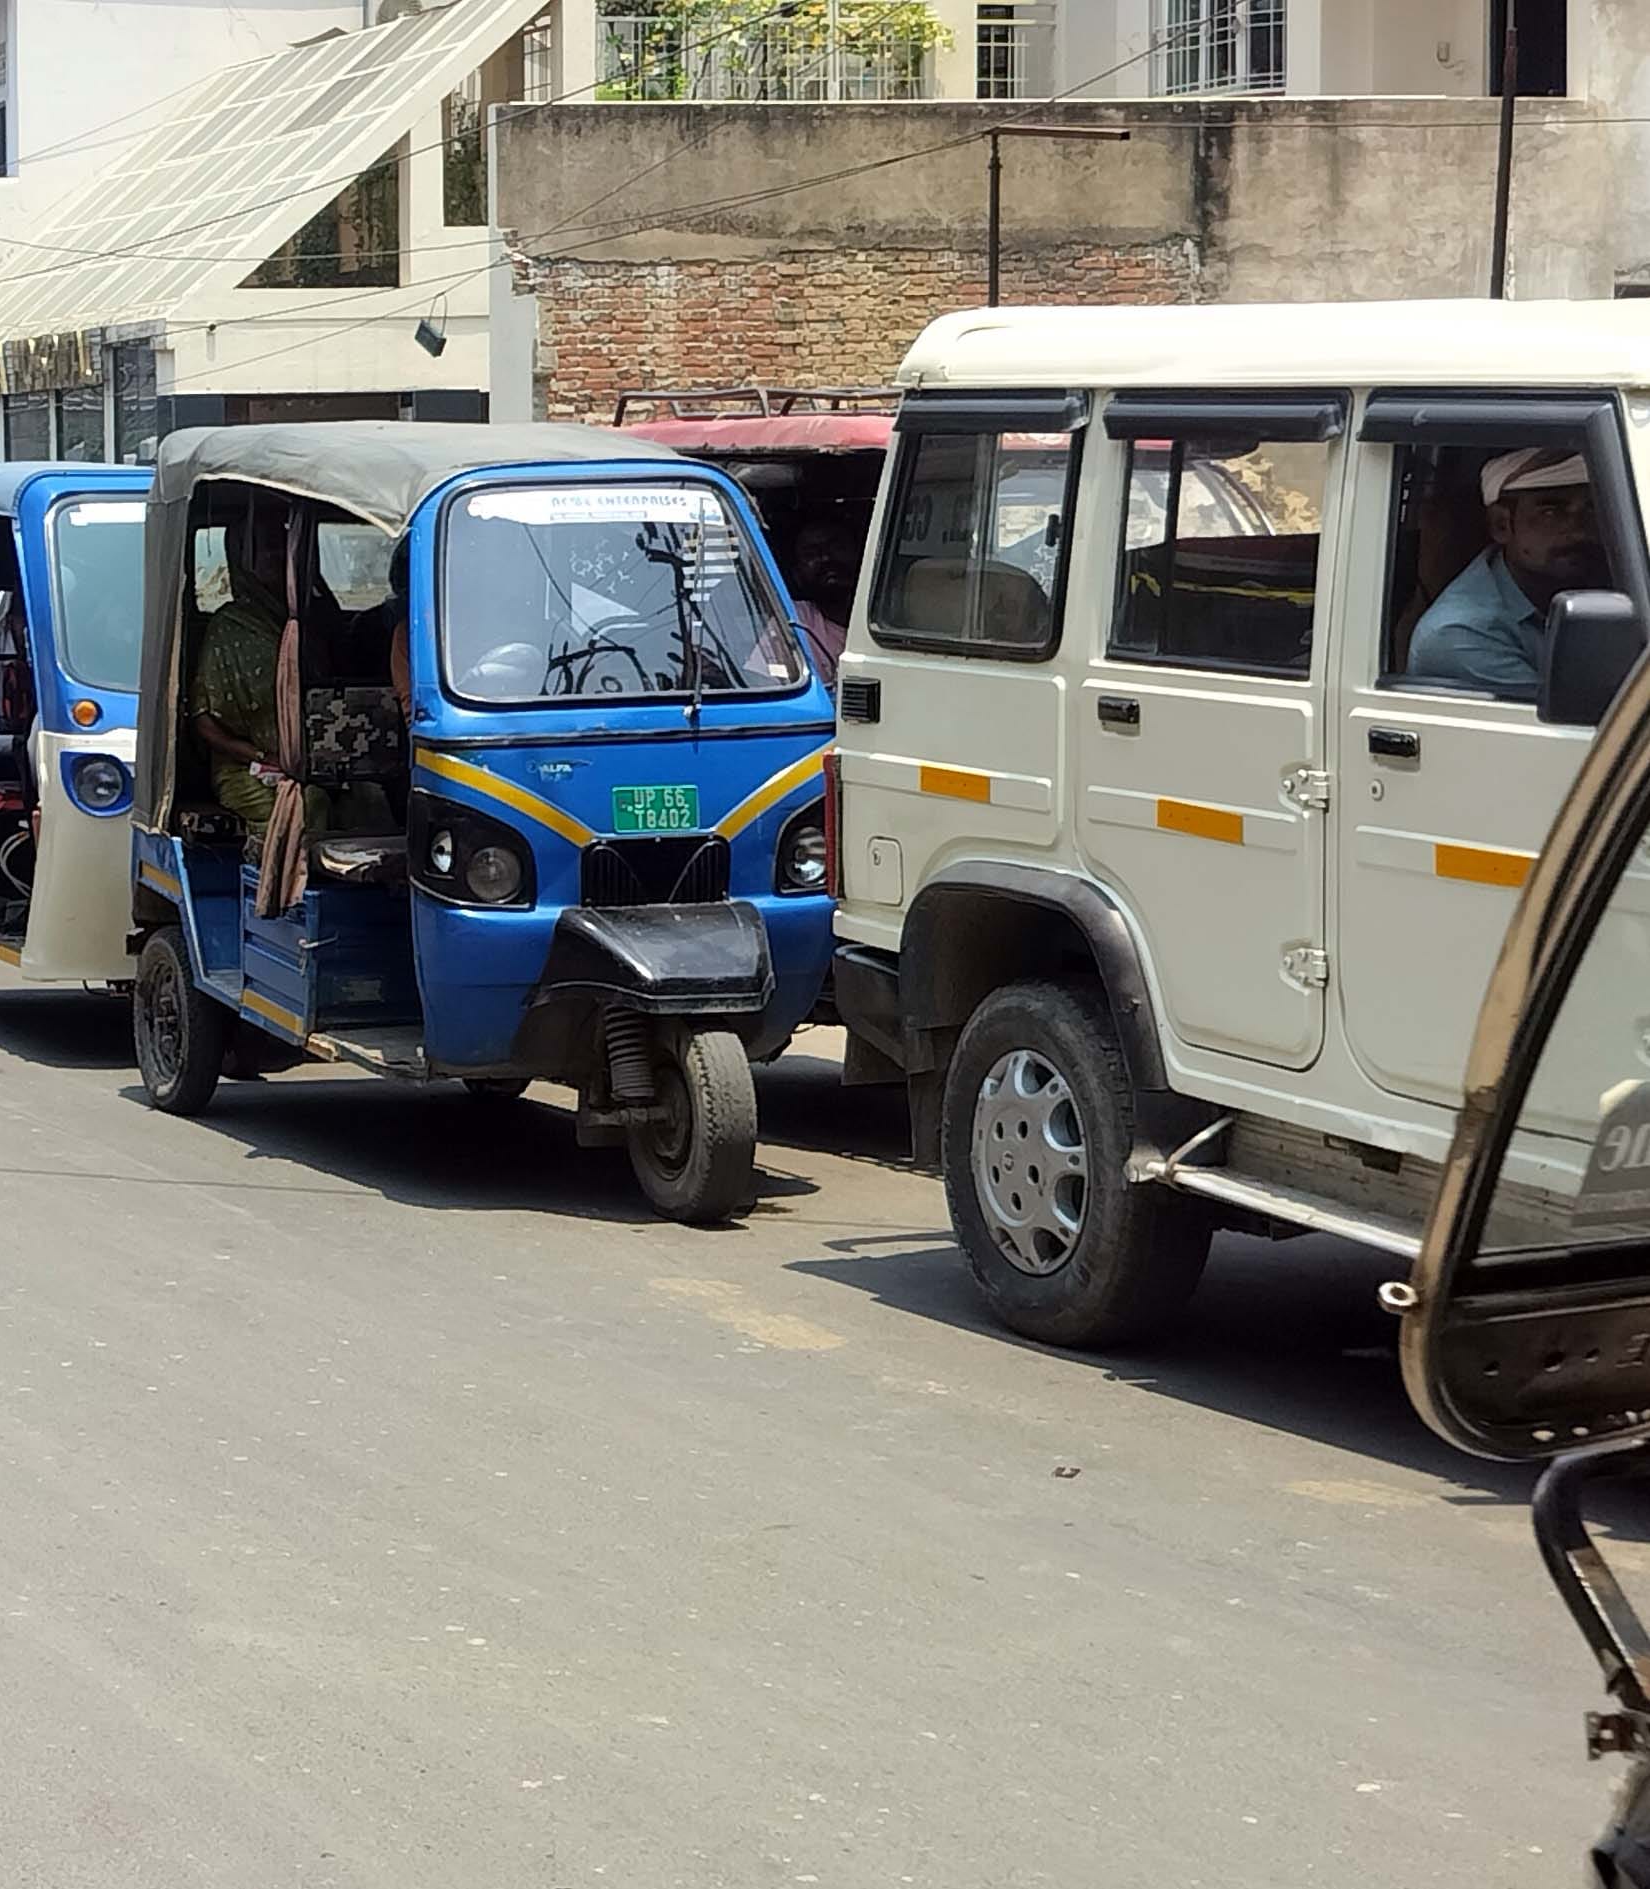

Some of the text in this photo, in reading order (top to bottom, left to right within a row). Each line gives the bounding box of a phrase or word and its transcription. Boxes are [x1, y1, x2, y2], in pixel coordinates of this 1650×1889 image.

[633, 788, 686, 809] UP 66
[633, 808, 691, 830] T8402
